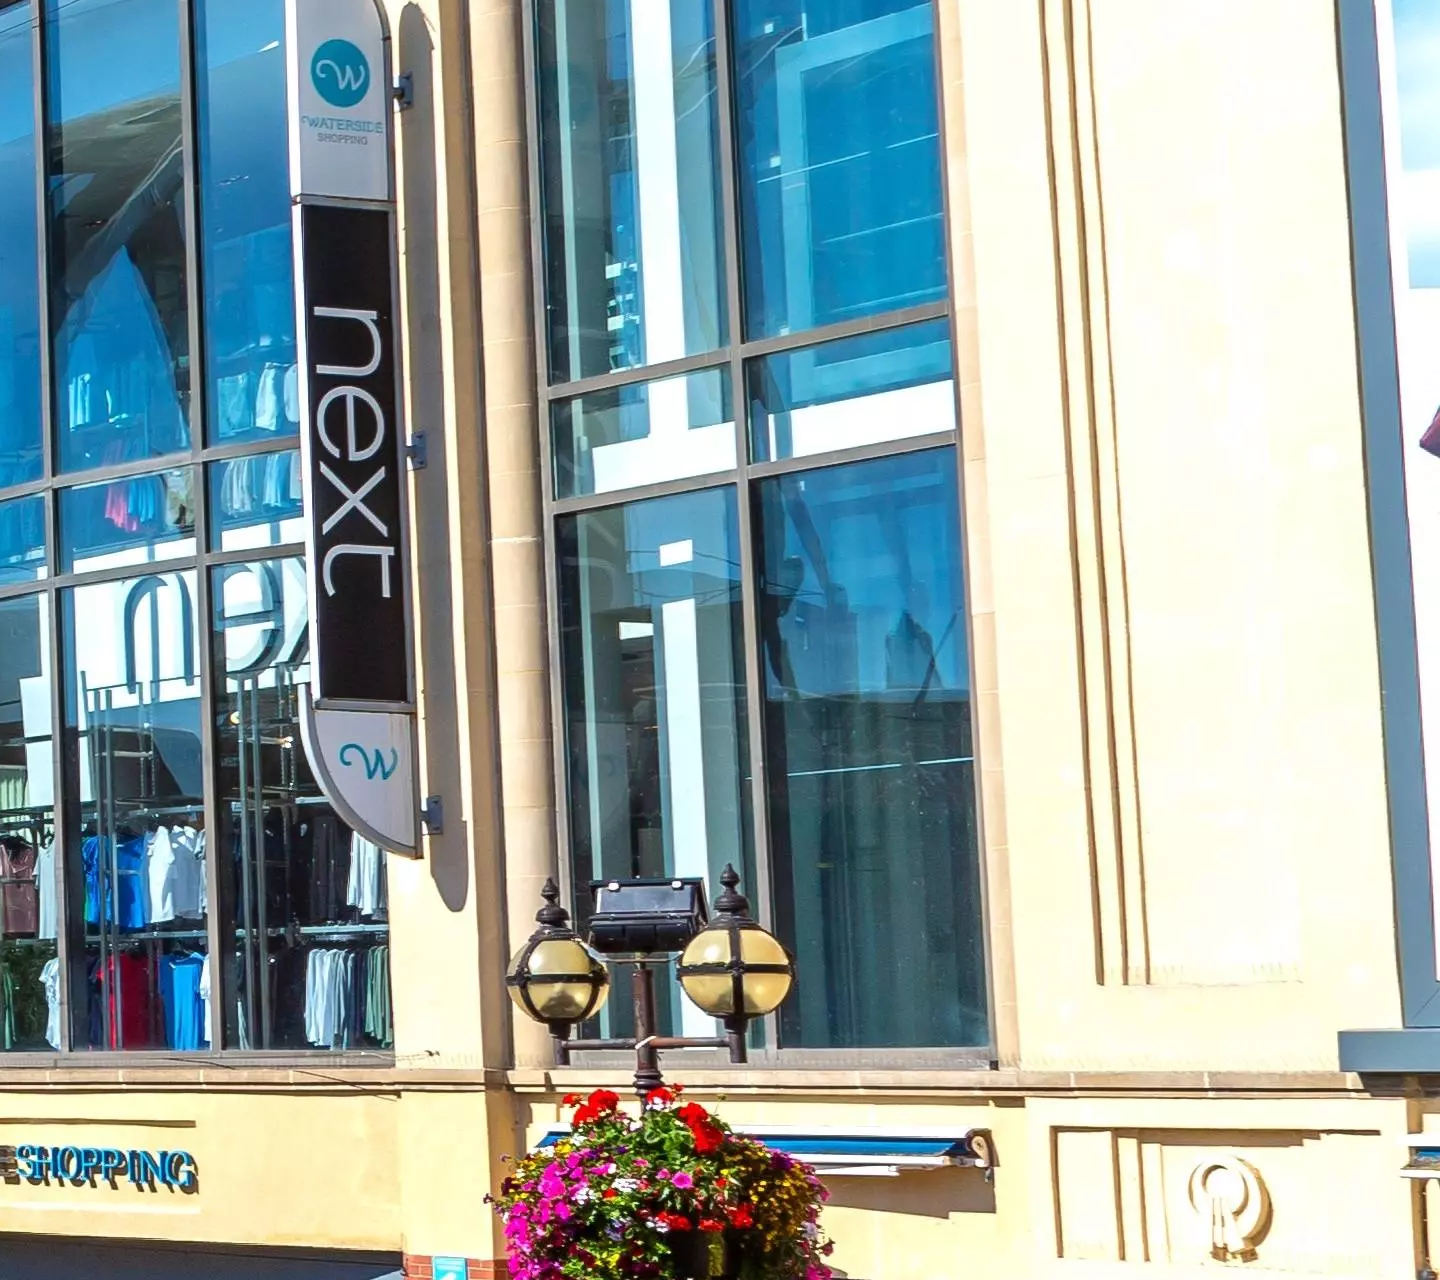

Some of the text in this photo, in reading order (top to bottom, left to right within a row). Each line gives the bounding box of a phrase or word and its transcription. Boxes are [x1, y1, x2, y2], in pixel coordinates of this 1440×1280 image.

[302, 115, 383, 134] WATERSIDE
[318, 133, 368, 145] SHOPPING
[314, 306, 396, 599] next
[16, 1144, 194, 1187] SHOPPING
